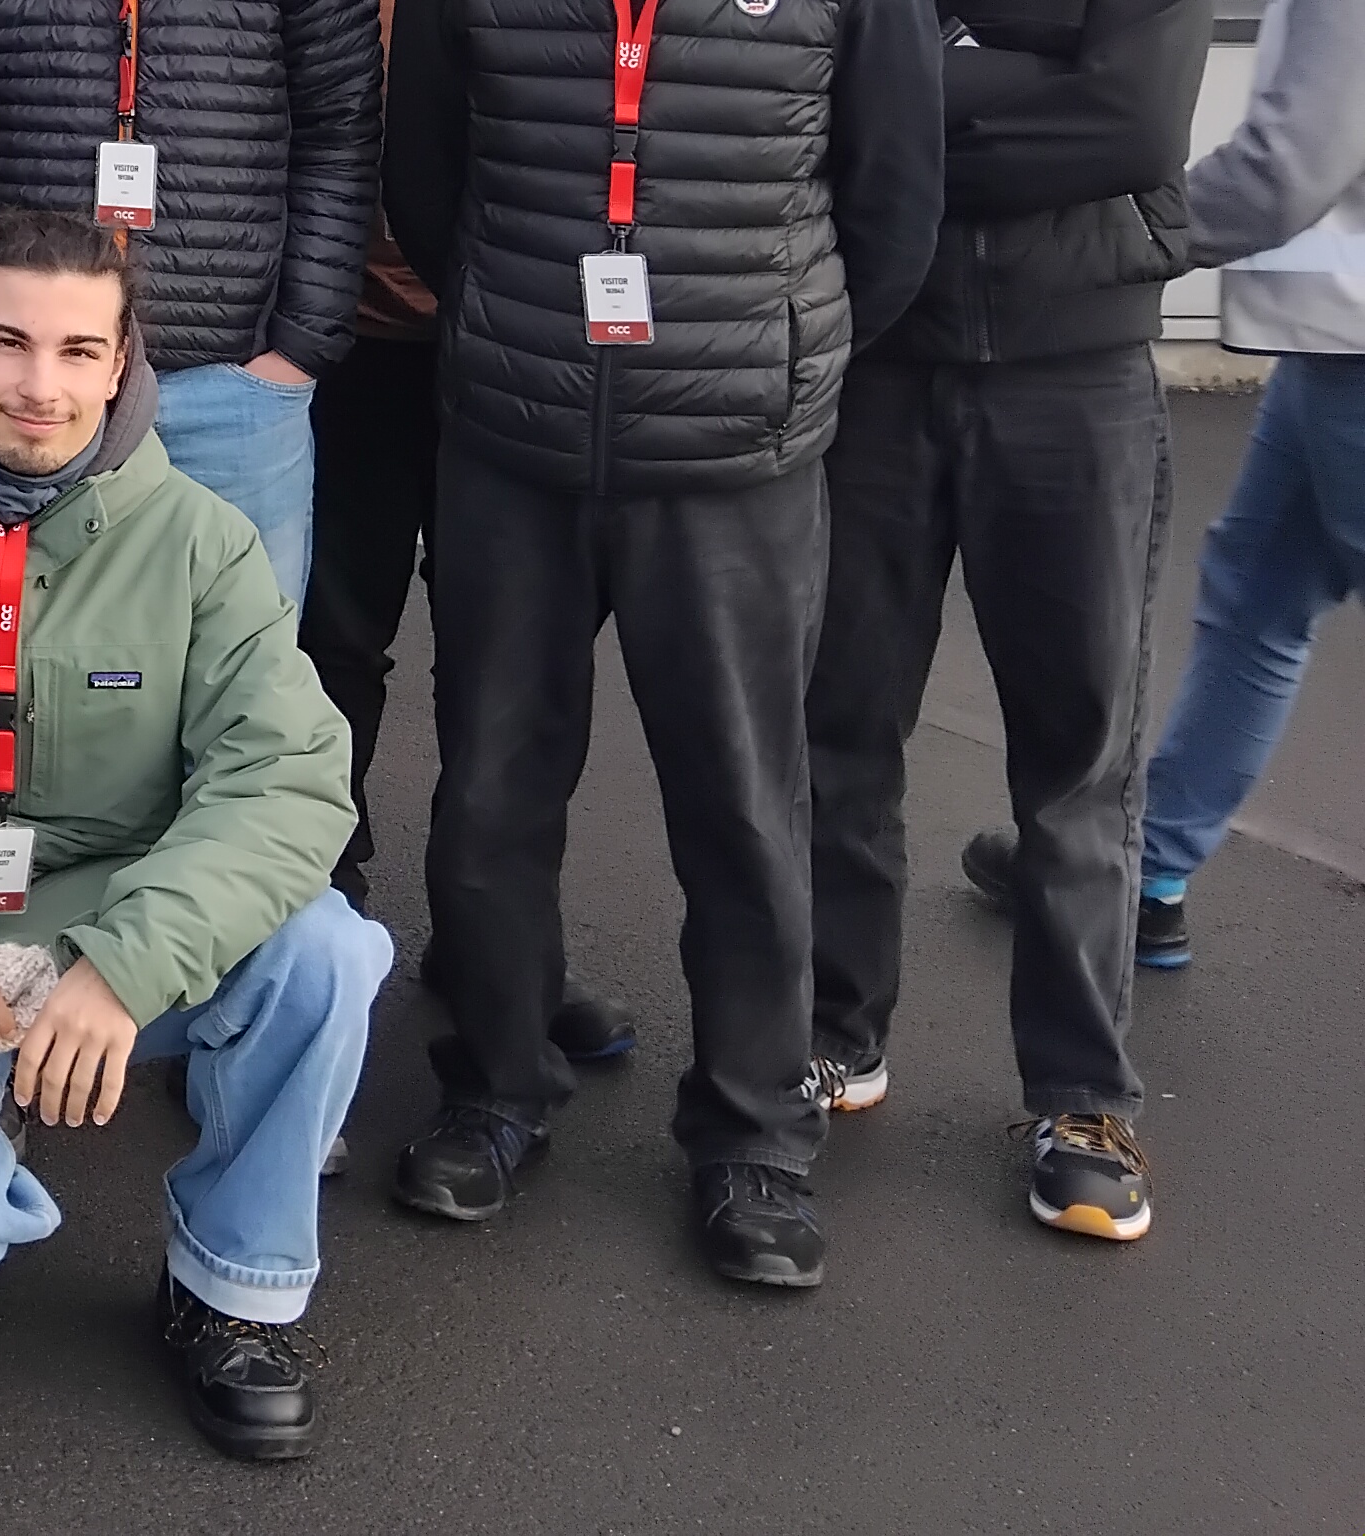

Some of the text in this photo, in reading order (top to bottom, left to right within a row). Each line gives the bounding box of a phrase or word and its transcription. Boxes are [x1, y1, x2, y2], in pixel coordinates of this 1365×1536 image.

[628, 43, 641, 68] acc
[114, 164, 139, 172] VISITOR
[114, 210, 136, 220] acc
[608, 326, 630, 334] acc
[0, 604, 12, 631] acc
